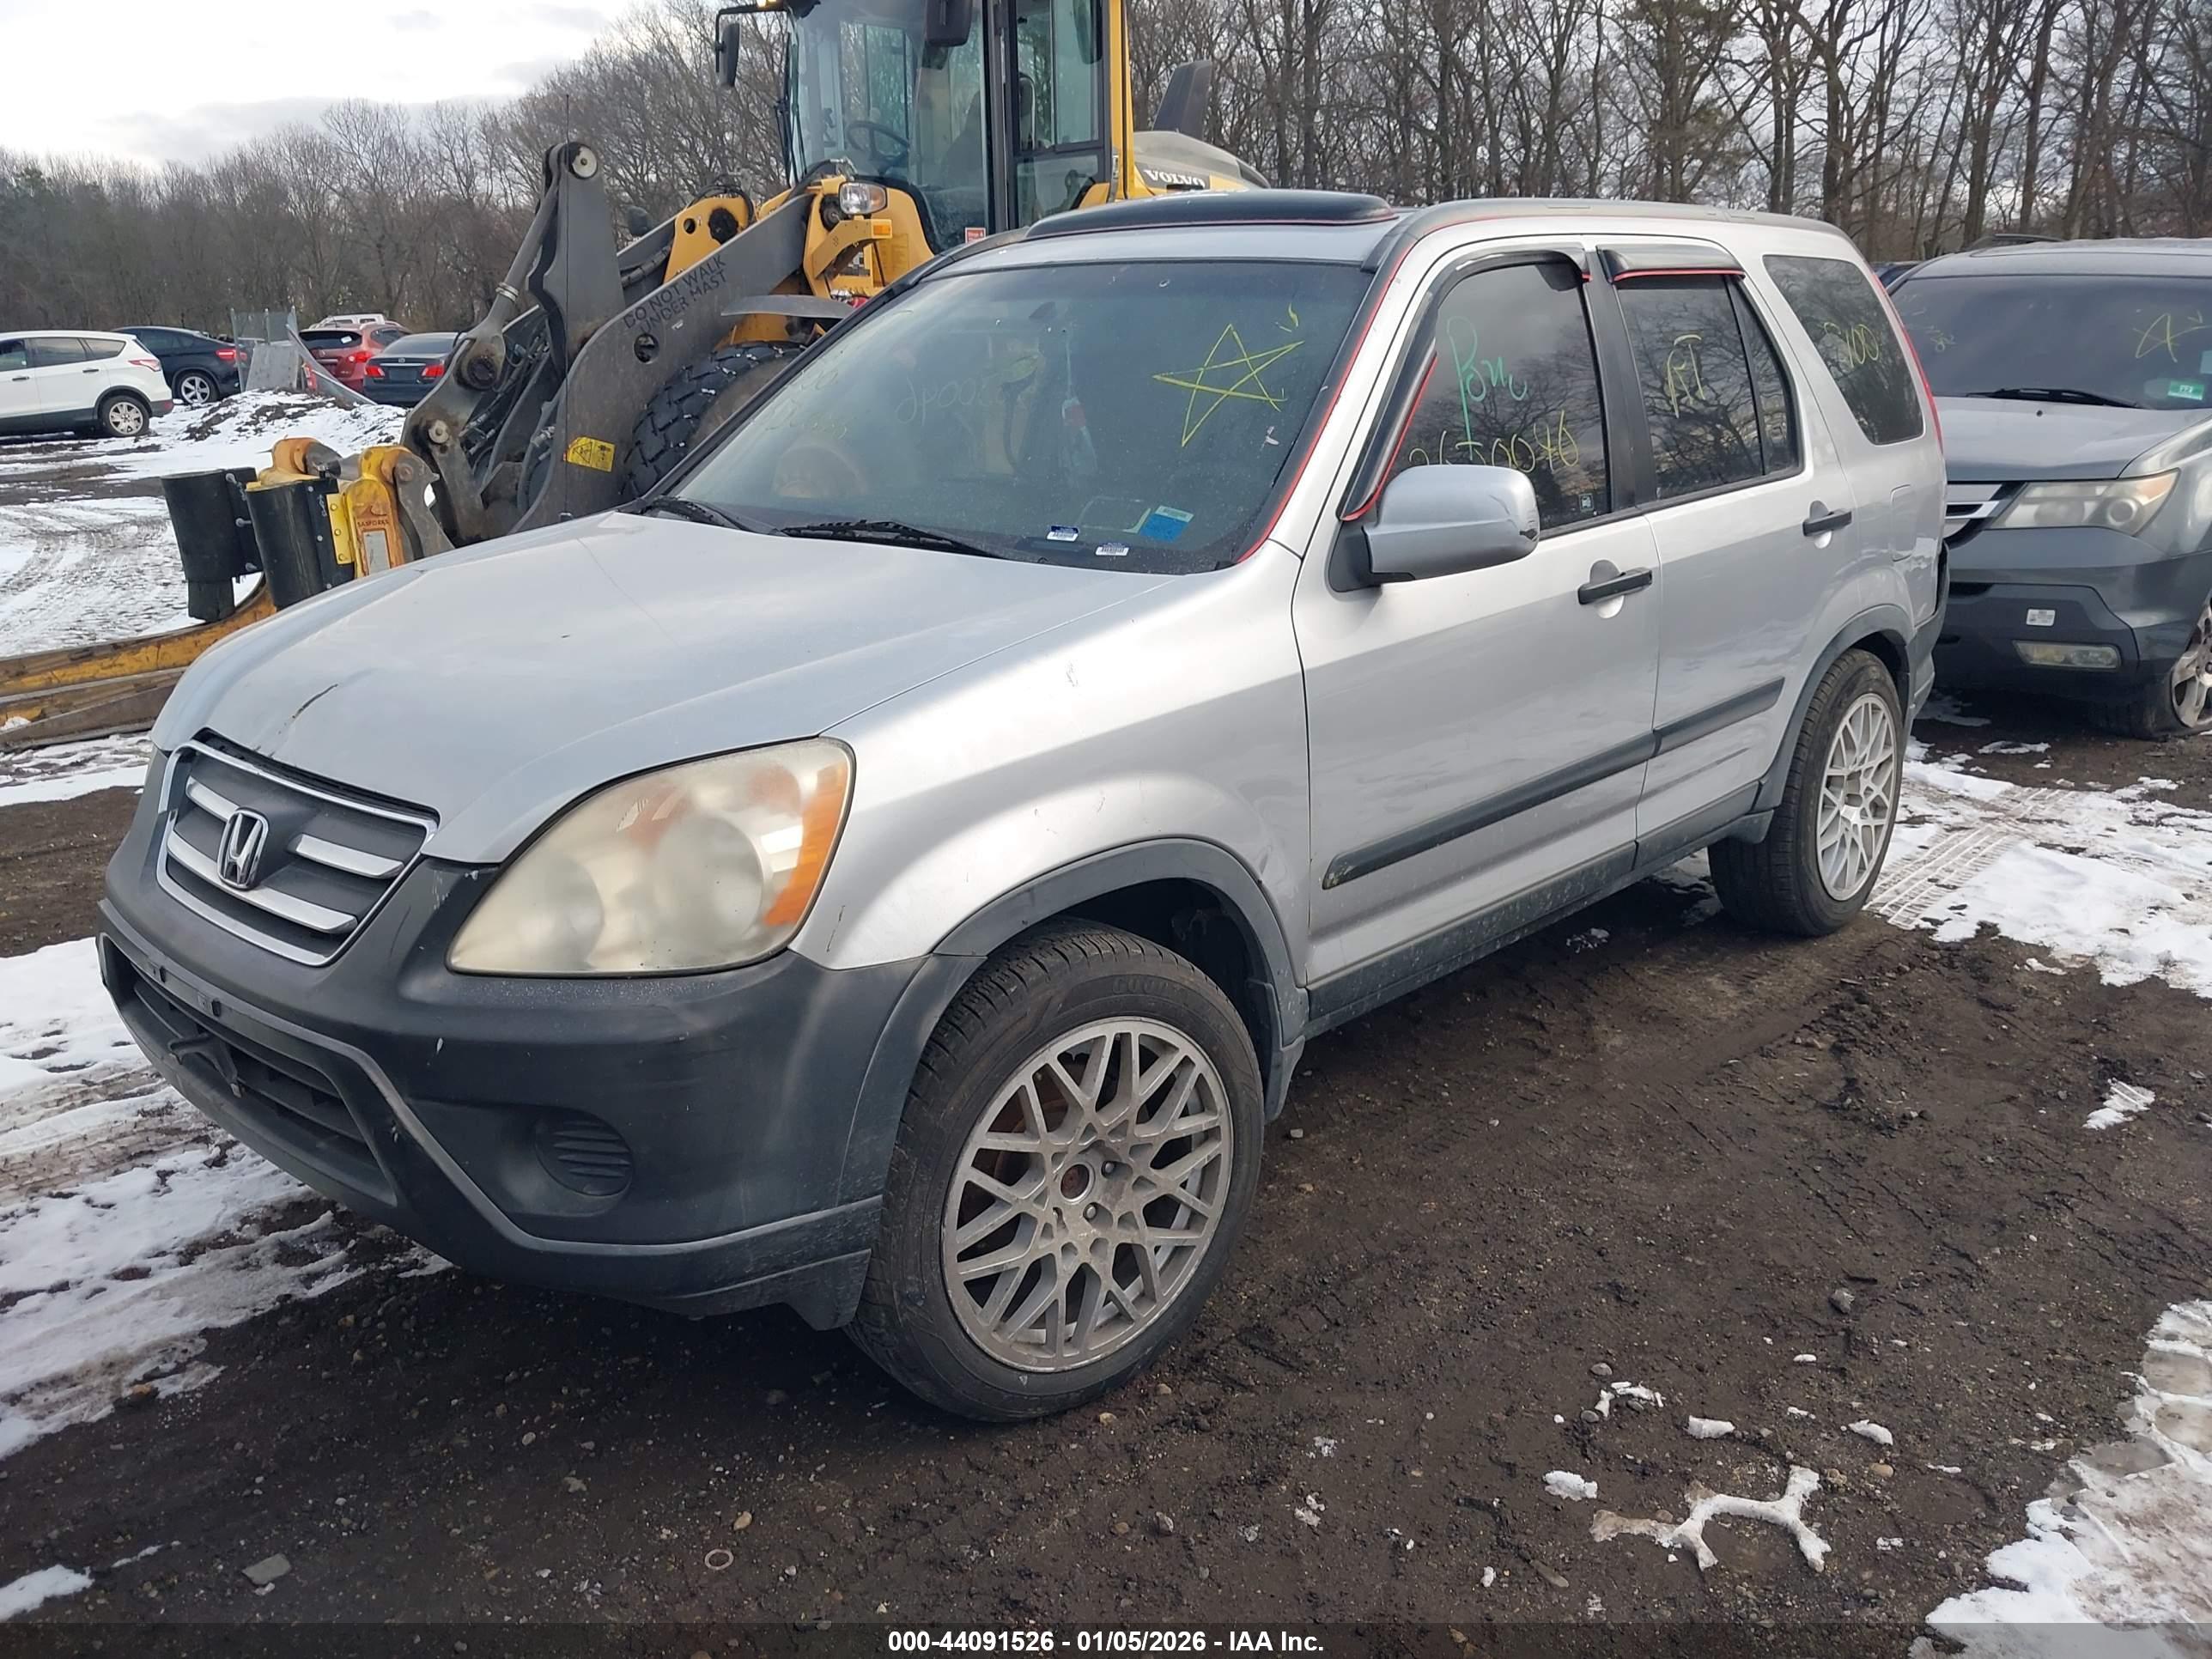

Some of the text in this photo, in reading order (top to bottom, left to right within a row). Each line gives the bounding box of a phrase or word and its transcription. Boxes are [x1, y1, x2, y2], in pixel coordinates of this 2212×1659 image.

[1143, 169, 1206, 188] VOLVO
[623, 254, 726, 329] DO NOT WALK
[641, 270, 726, 333] UNDER MAST
